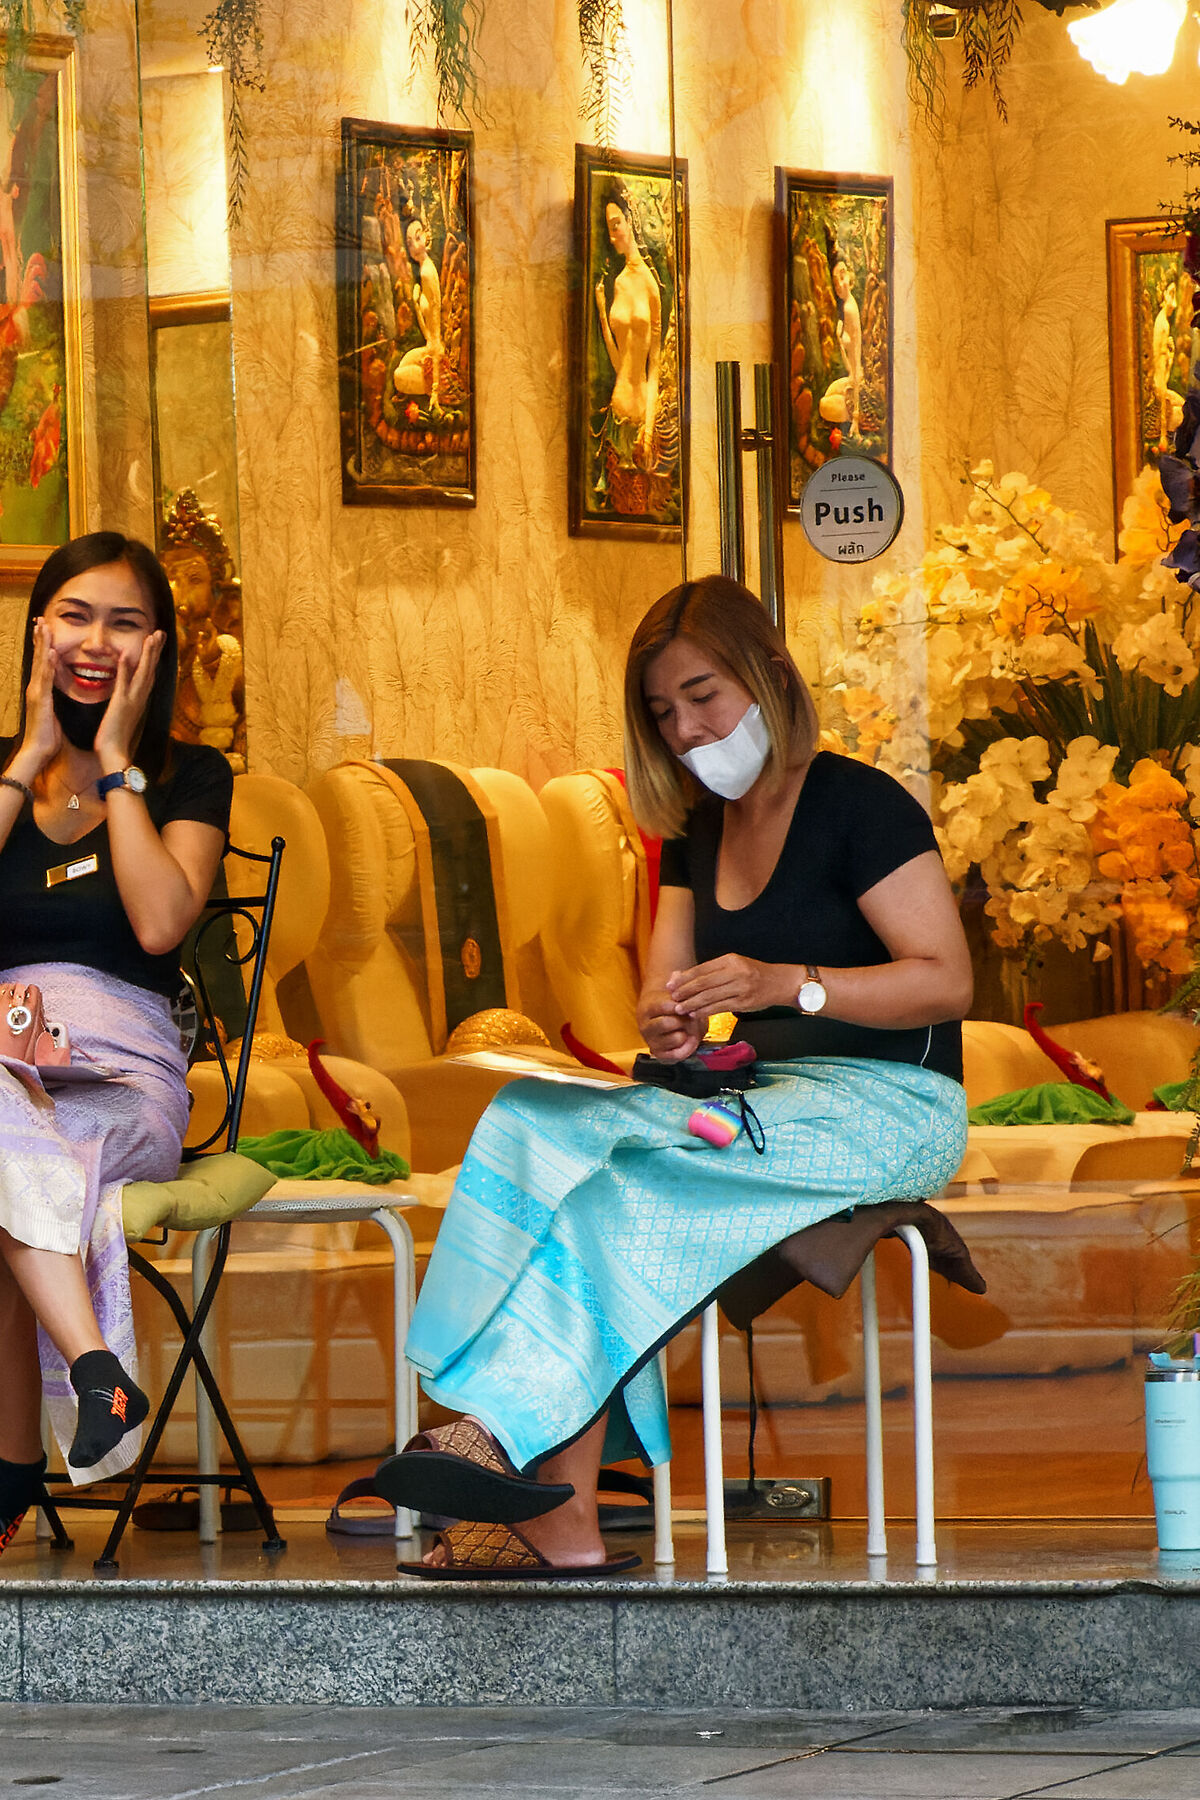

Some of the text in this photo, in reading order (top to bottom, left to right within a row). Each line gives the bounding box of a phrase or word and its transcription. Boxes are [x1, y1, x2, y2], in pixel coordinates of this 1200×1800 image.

[831, 473, 866, 482] Please
[815, 497, 884, 526] Push
[838, 541, 864, 555] ผลัก
[110, 1386, 128, 1423] TIGER
